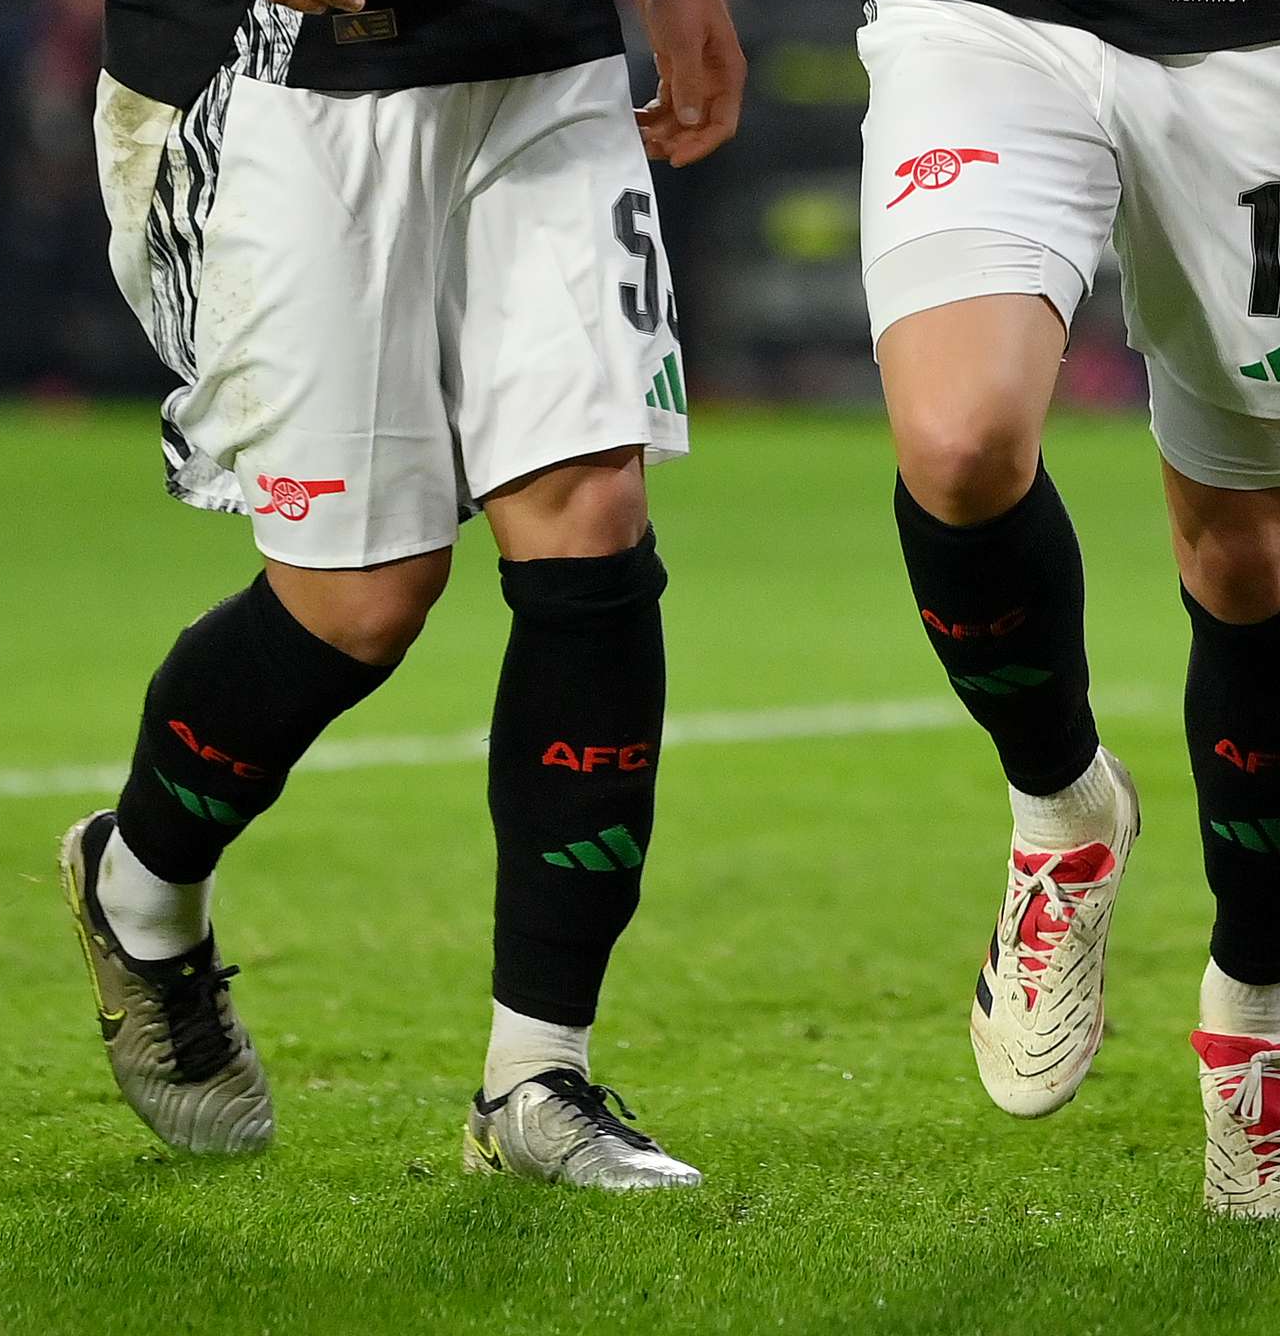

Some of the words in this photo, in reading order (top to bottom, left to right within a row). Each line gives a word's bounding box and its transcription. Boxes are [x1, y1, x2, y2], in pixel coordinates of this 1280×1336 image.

[610, 187, 680, 344] 5
[167, 719, 265, 777] AFC
[542, 741, 650, 773] AFC
